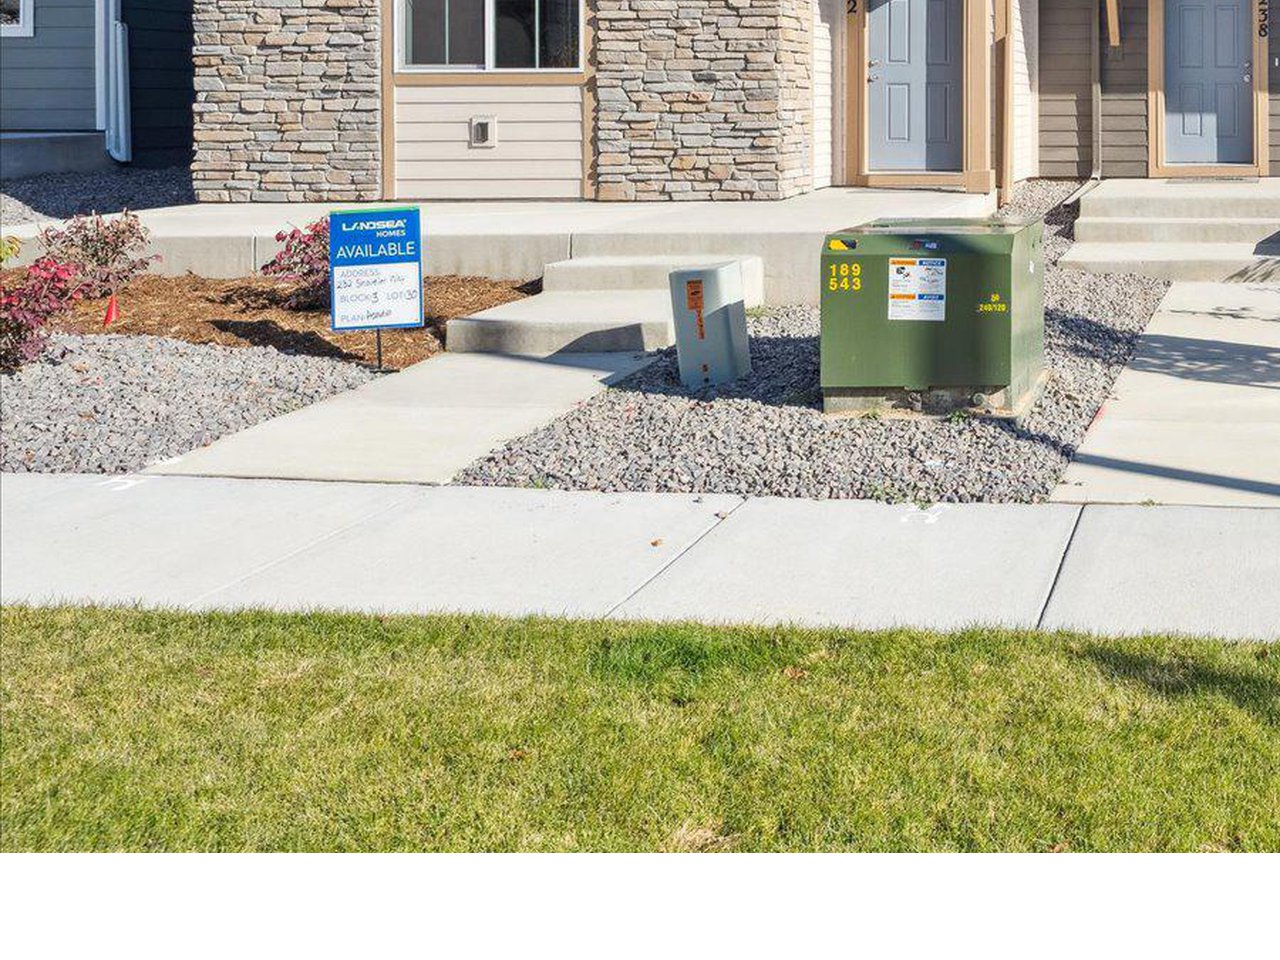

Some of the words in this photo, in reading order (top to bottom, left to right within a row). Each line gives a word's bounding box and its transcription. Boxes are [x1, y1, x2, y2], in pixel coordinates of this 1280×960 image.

[376, 229, 406, 238] HOMES
[336, 241, 416, 259] AVAILABLE
[829, 263, 862, 277] 189
[828, 277, 862, 291] 543
